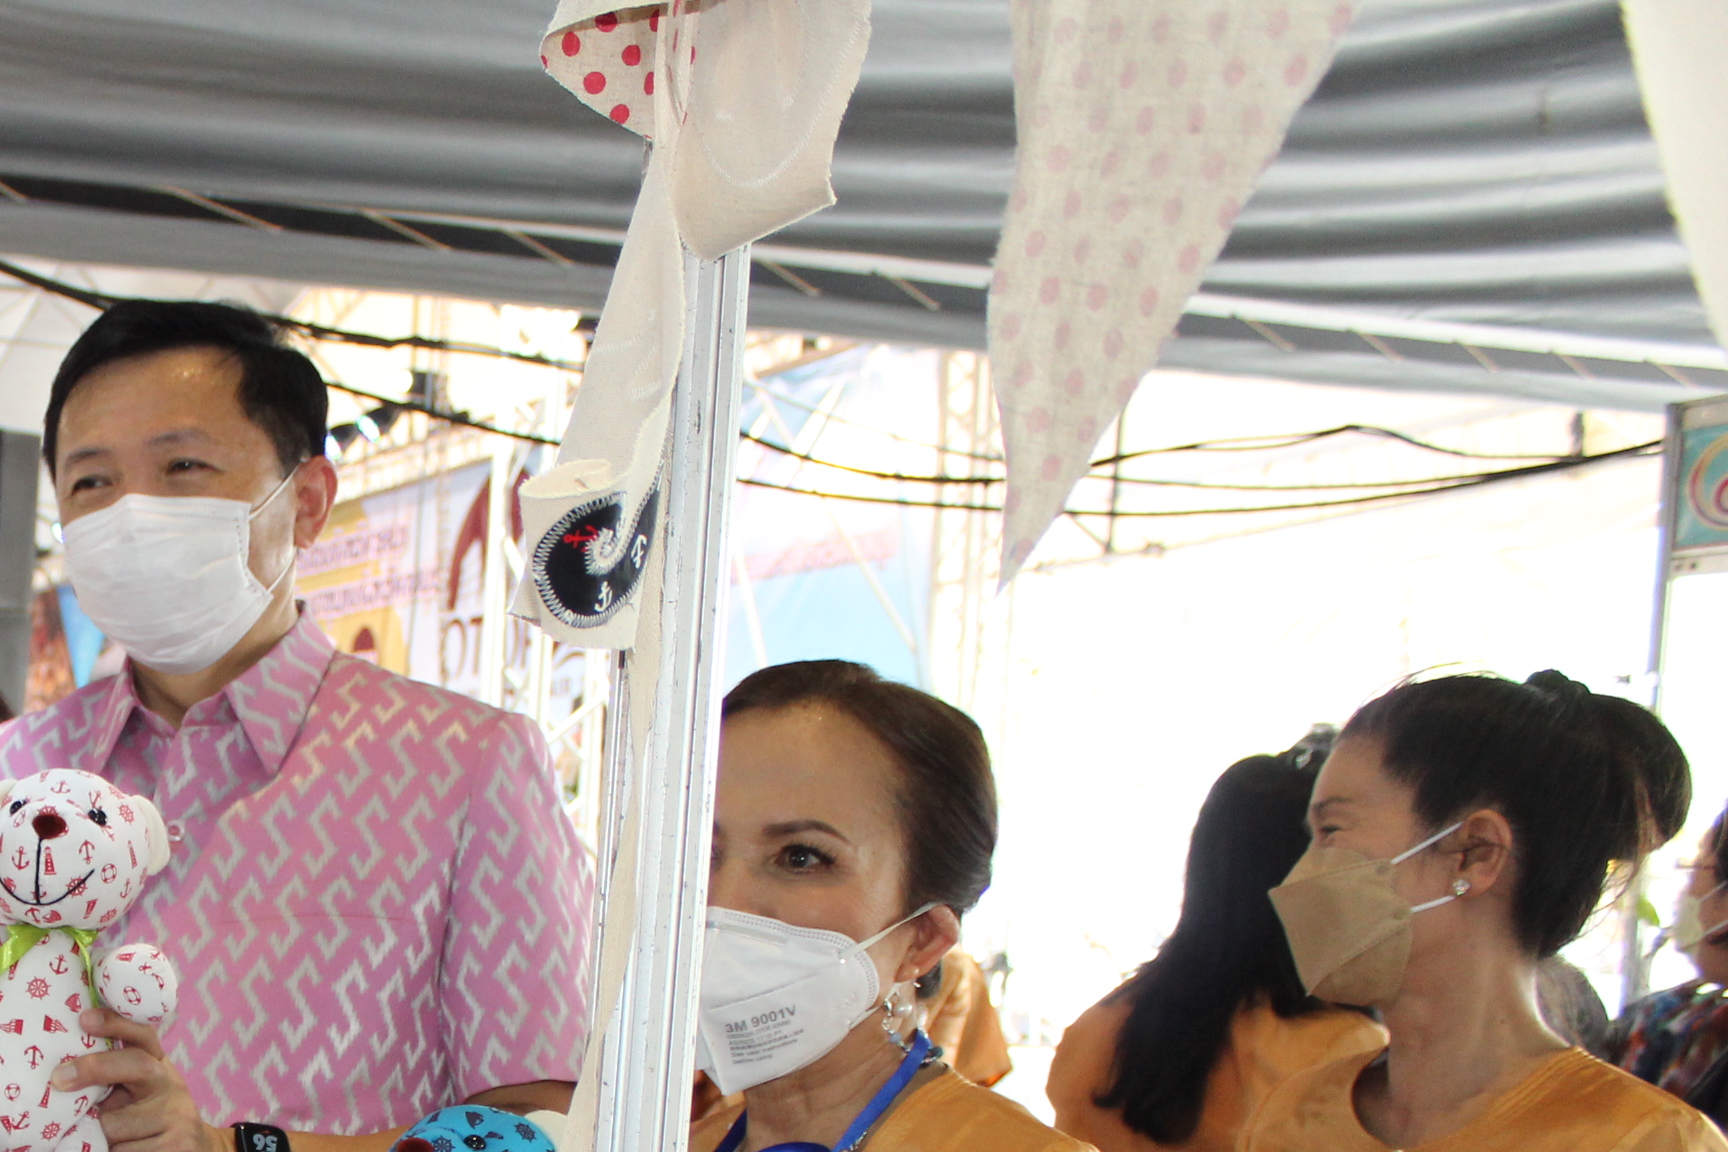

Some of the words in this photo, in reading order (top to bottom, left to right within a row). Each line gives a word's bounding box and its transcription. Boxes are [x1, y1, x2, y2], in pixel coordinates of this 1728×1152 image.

[725, 1020, 748, 1034] 3M
[751, 1004, 797, 1028] 9001V
[252, 1133, 278, 1152] 56
